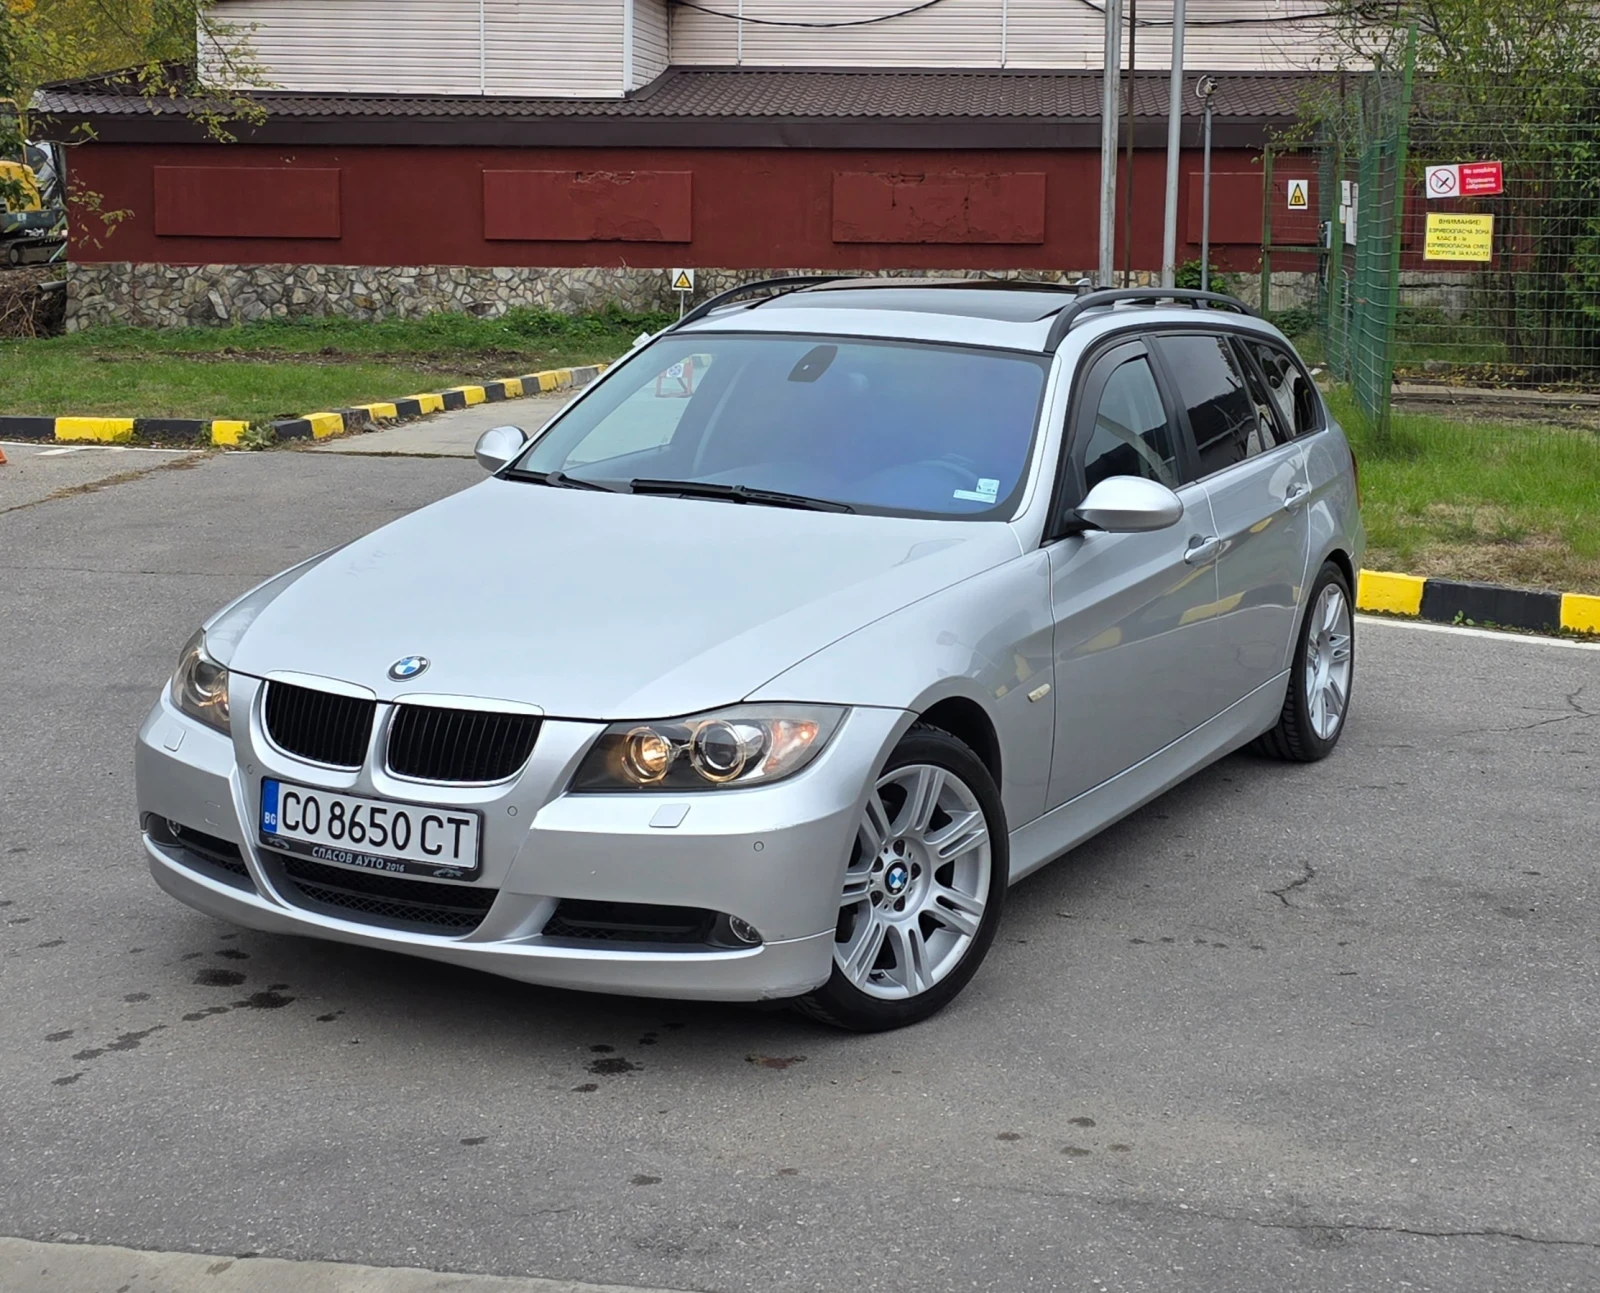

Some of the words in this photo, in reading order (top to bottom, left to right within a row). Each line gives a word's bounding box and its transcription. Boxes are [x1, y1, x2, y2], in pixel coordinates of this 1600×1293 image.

[264, 811, 277, 825] BG
[328, 801, 412, 850] 8650
[420, 814, 470, 859] CT
[312, 846, 353, 864] СПАСОВ
[355, 855, 384, 869] АУТО
[386, 862, 405, 872] 2016
